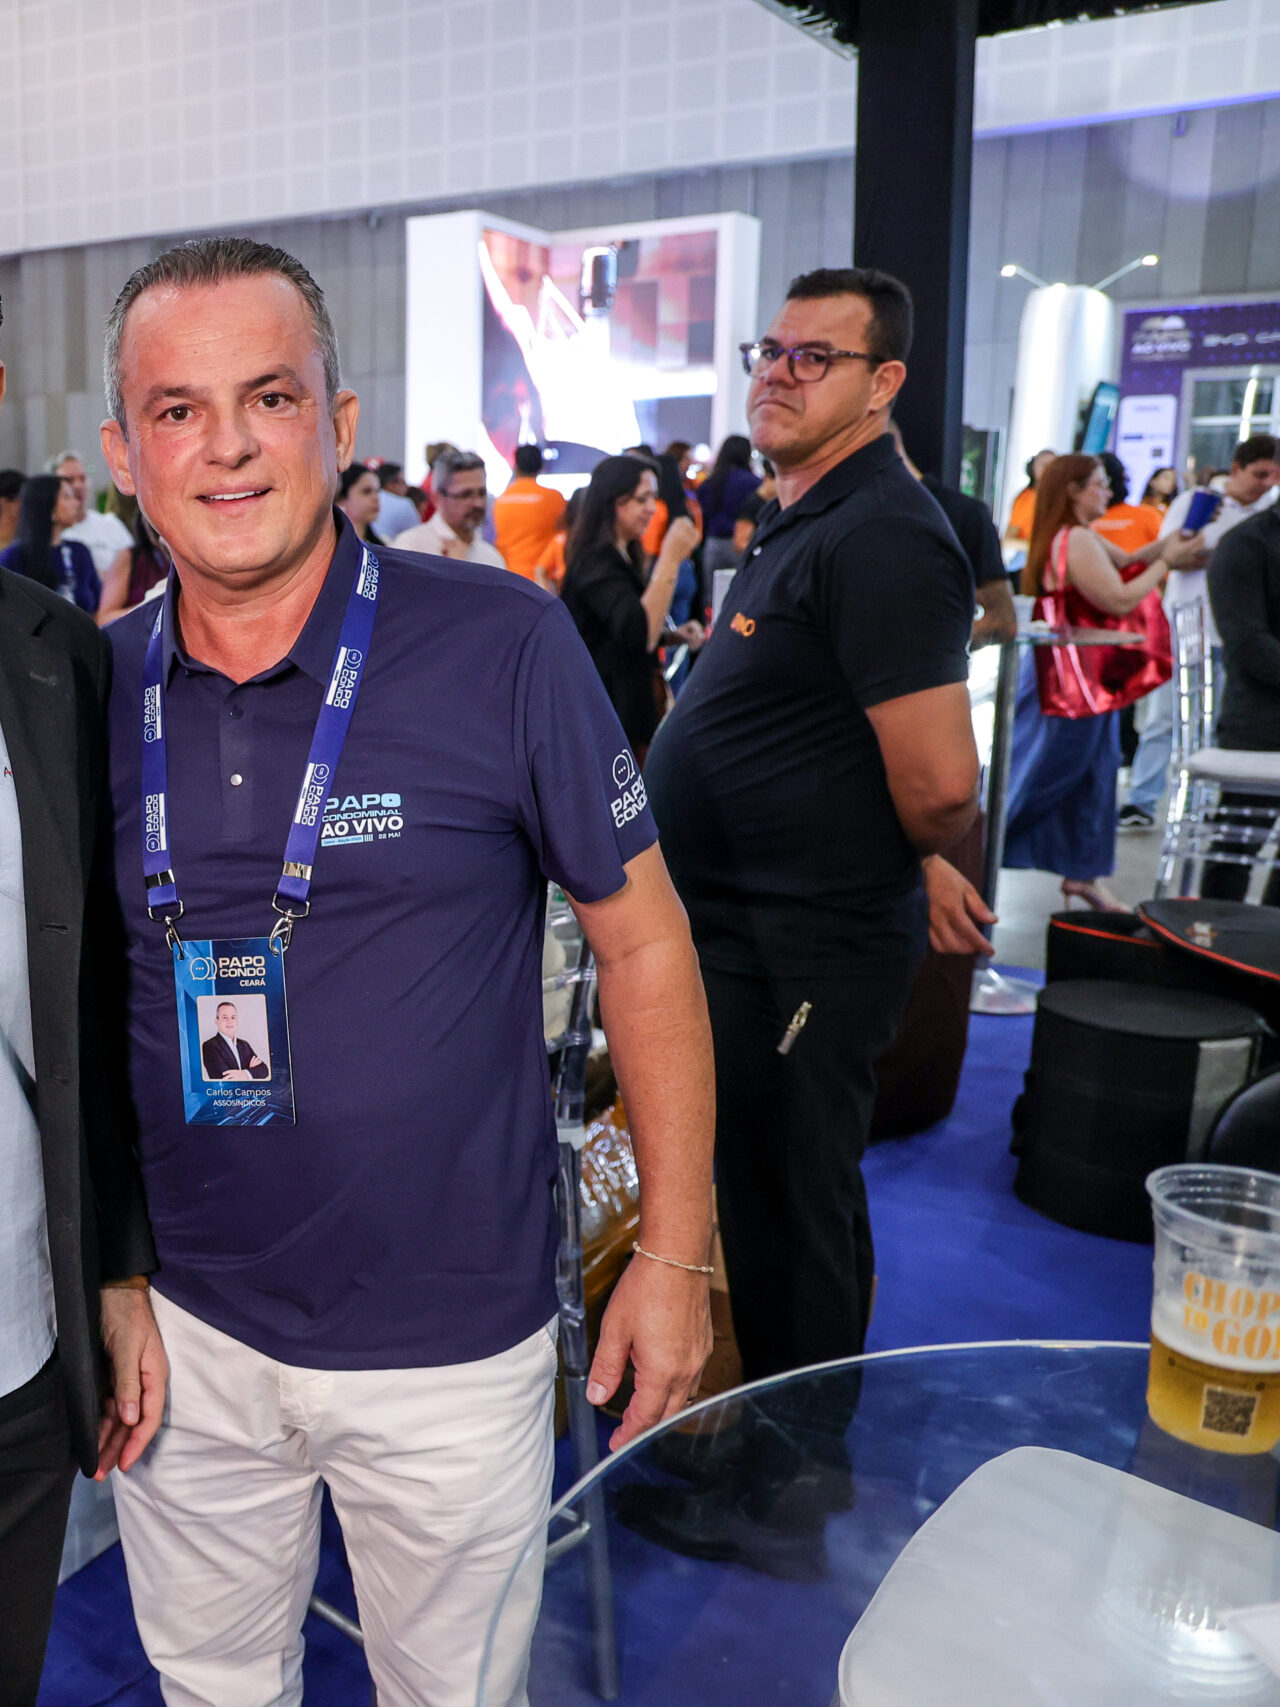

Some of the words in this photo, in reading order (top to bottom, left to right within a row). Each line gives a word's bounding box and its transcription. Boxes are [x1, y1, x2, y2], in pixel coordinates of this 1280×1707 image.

[362, 565, 373, 598] CONDO
[368, 568, 379, 601] PAPO
[333, 668, 349, 707] CONDO
[340, 670, 358, 709] PAPO
[301, 784, 316, 825] CONDO
[307, 785, 324, 826] PAPO
[324, 793, 401, 814] PAPO
[321, 821, 349, 838] AO
[352, 816, 404, 834] VIVO
[322, 809, 402, 823] CONDOMINIAL
[219, 956, 266, 968] PAPO
[220, 967, 266, 978] CONDO
[239, 978, 266, 987] CEARÁ
[206, 1088, 233, 1096] Carlos
[235, 1088, 272, 1099] Campos
